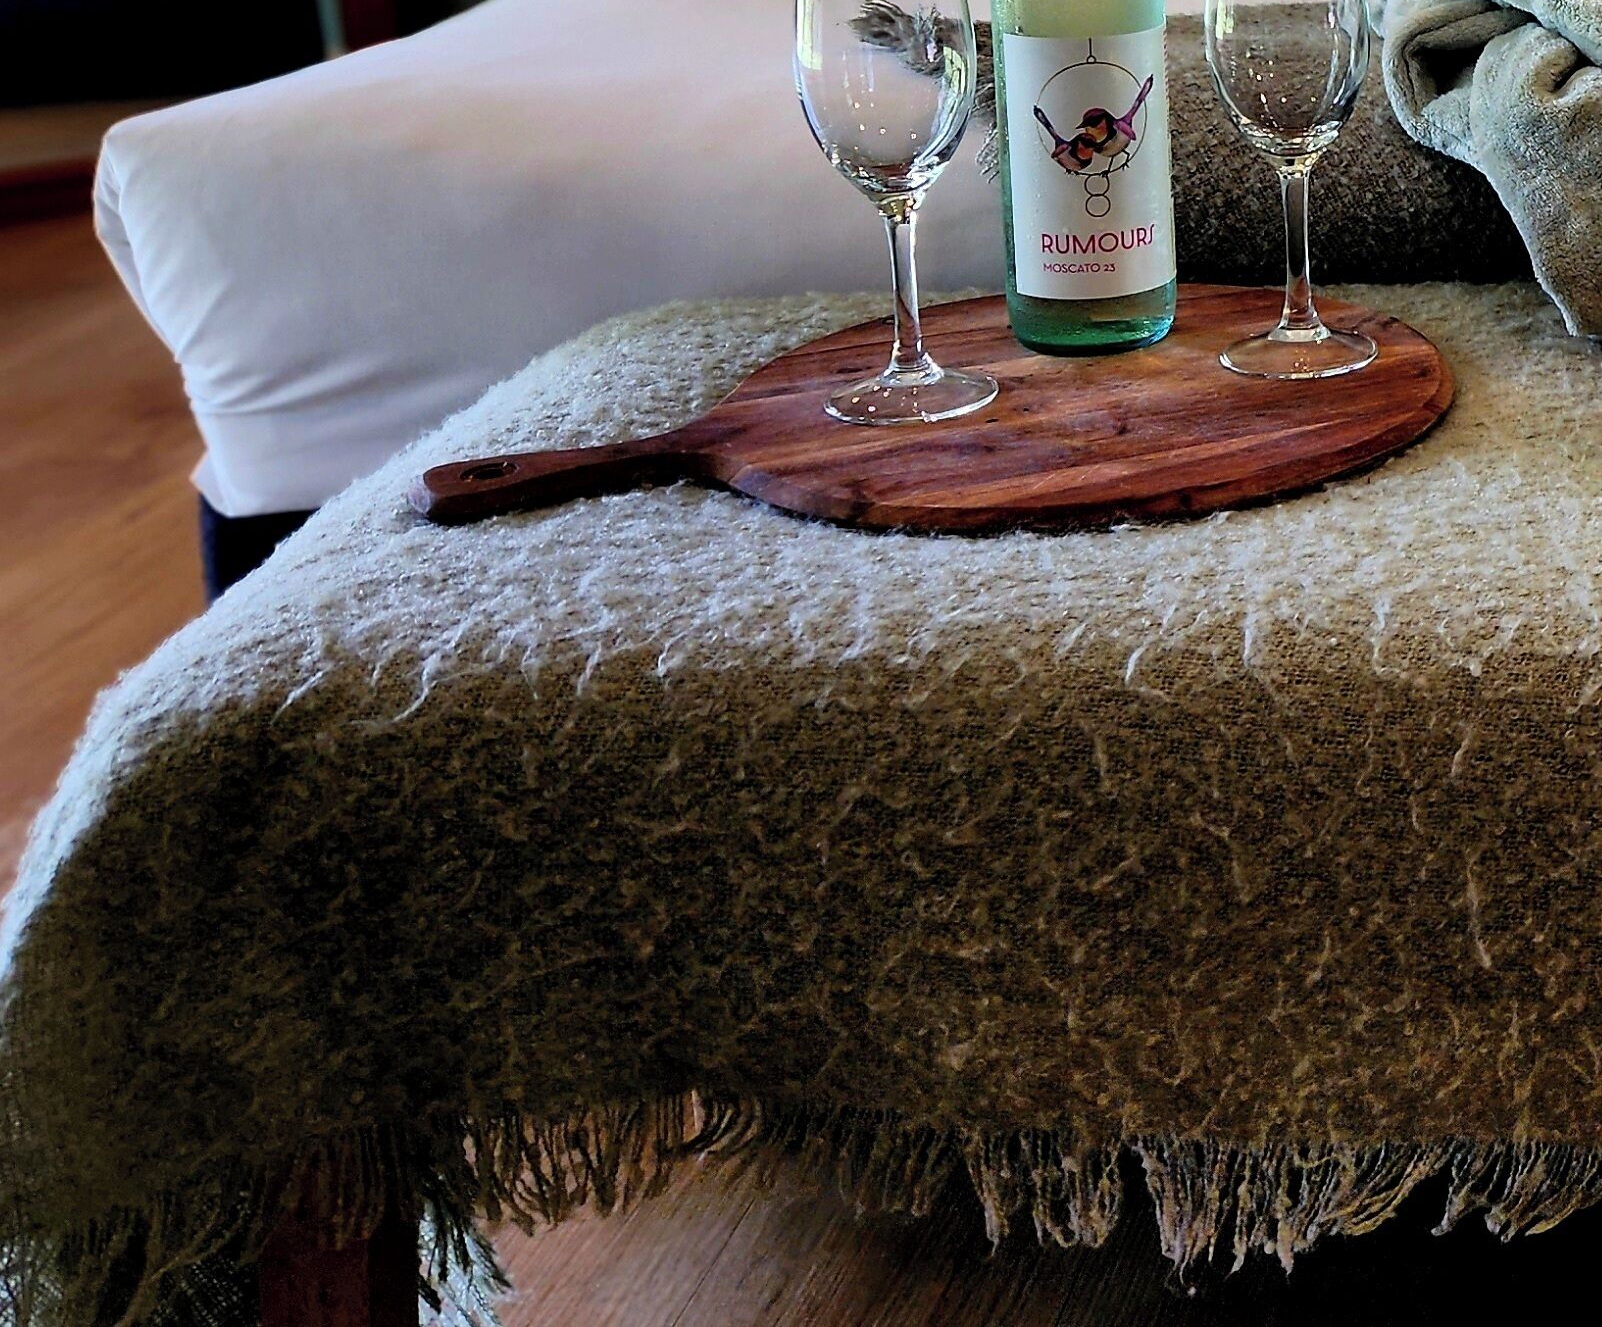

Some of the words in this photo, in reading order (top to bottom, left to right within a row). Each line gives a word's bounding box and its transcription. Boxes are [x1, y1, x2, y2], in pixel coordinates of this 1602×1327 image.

[1041, 223, 1155, 254] RUMOURS
[1043, 262, 1101, 274] MOSCATO
[1103, 262, 1116, 272] 23
